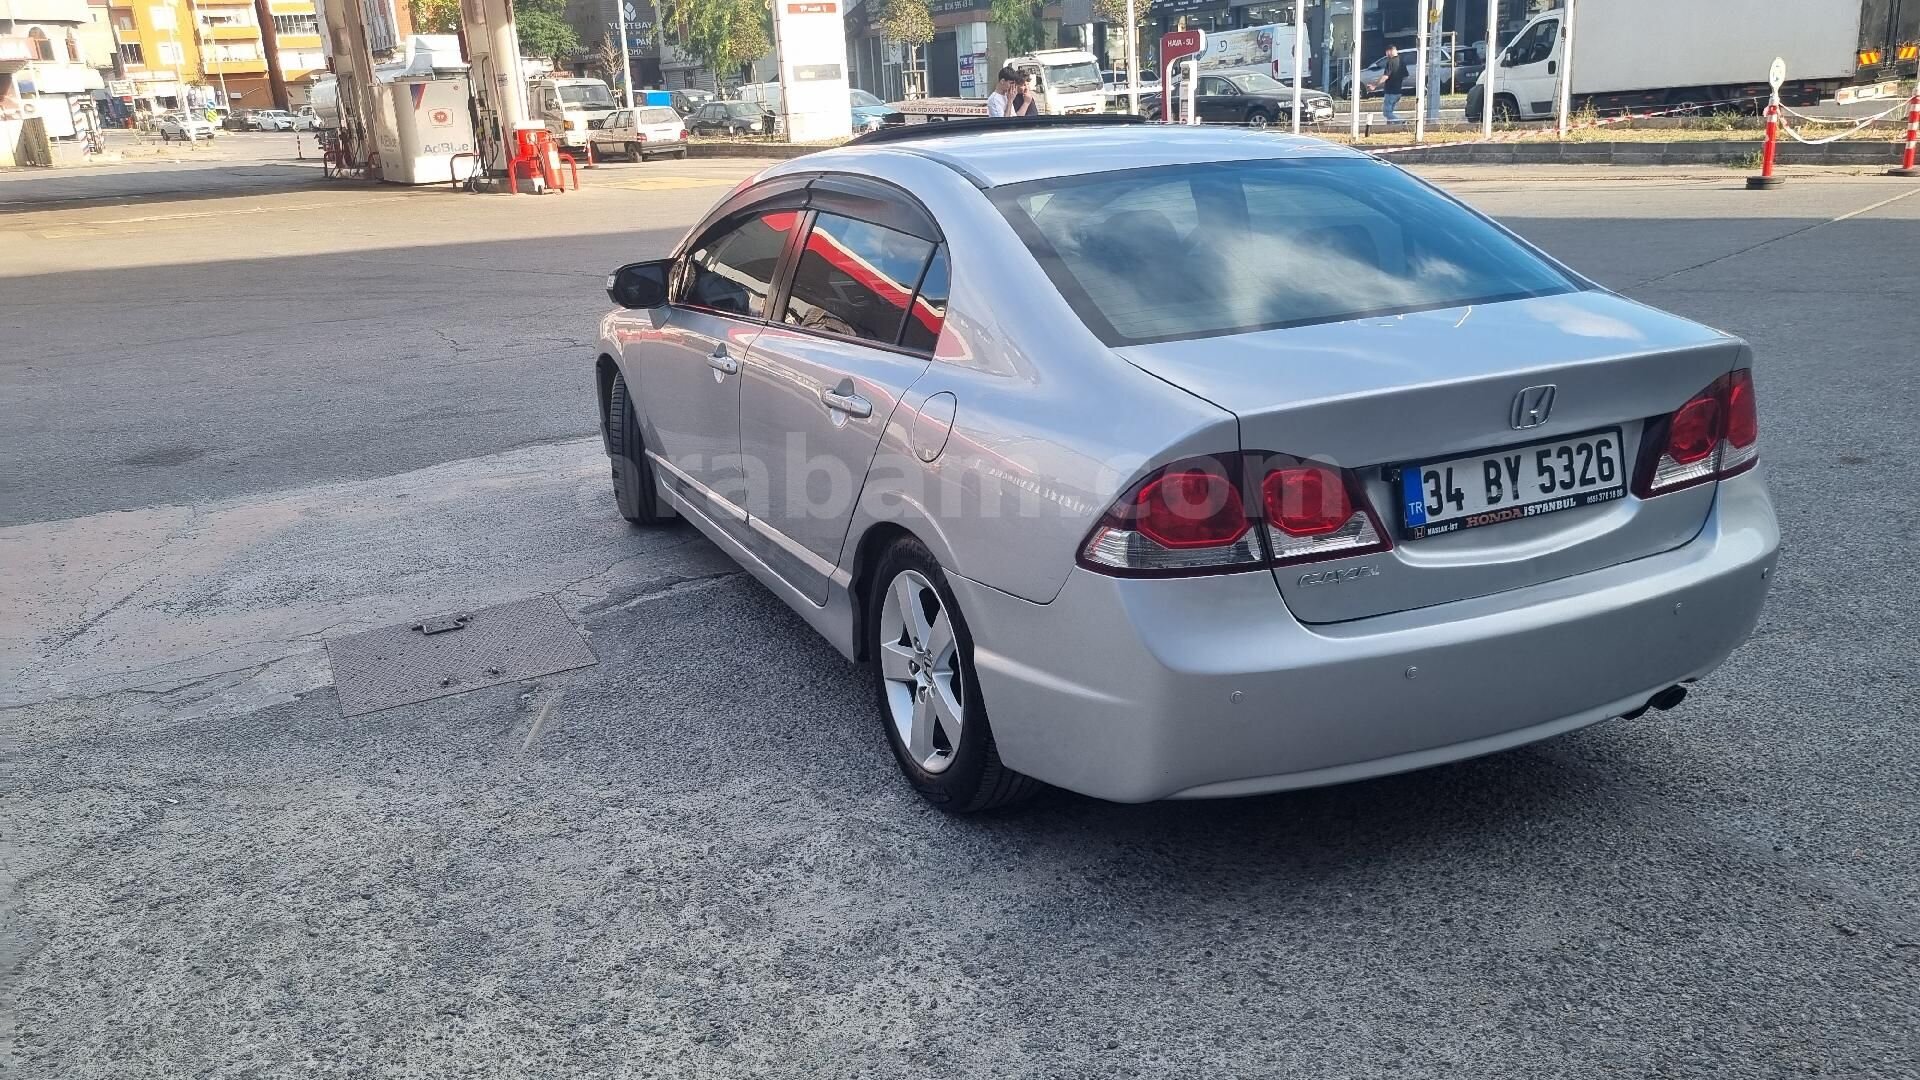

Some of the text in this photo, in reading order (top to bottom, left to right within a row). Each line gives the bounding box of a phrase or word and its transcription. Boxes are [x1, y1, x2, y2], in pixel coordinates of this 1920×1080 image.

[1186, 38, 1194, 46] SU
[423, 142, 469, 154] AdBlue
[1423, 438, 1615, 517] 34 BY 5326
[1408, 502, 1423, 516] TR
[1466, 506, 1524, 528] HONDA
